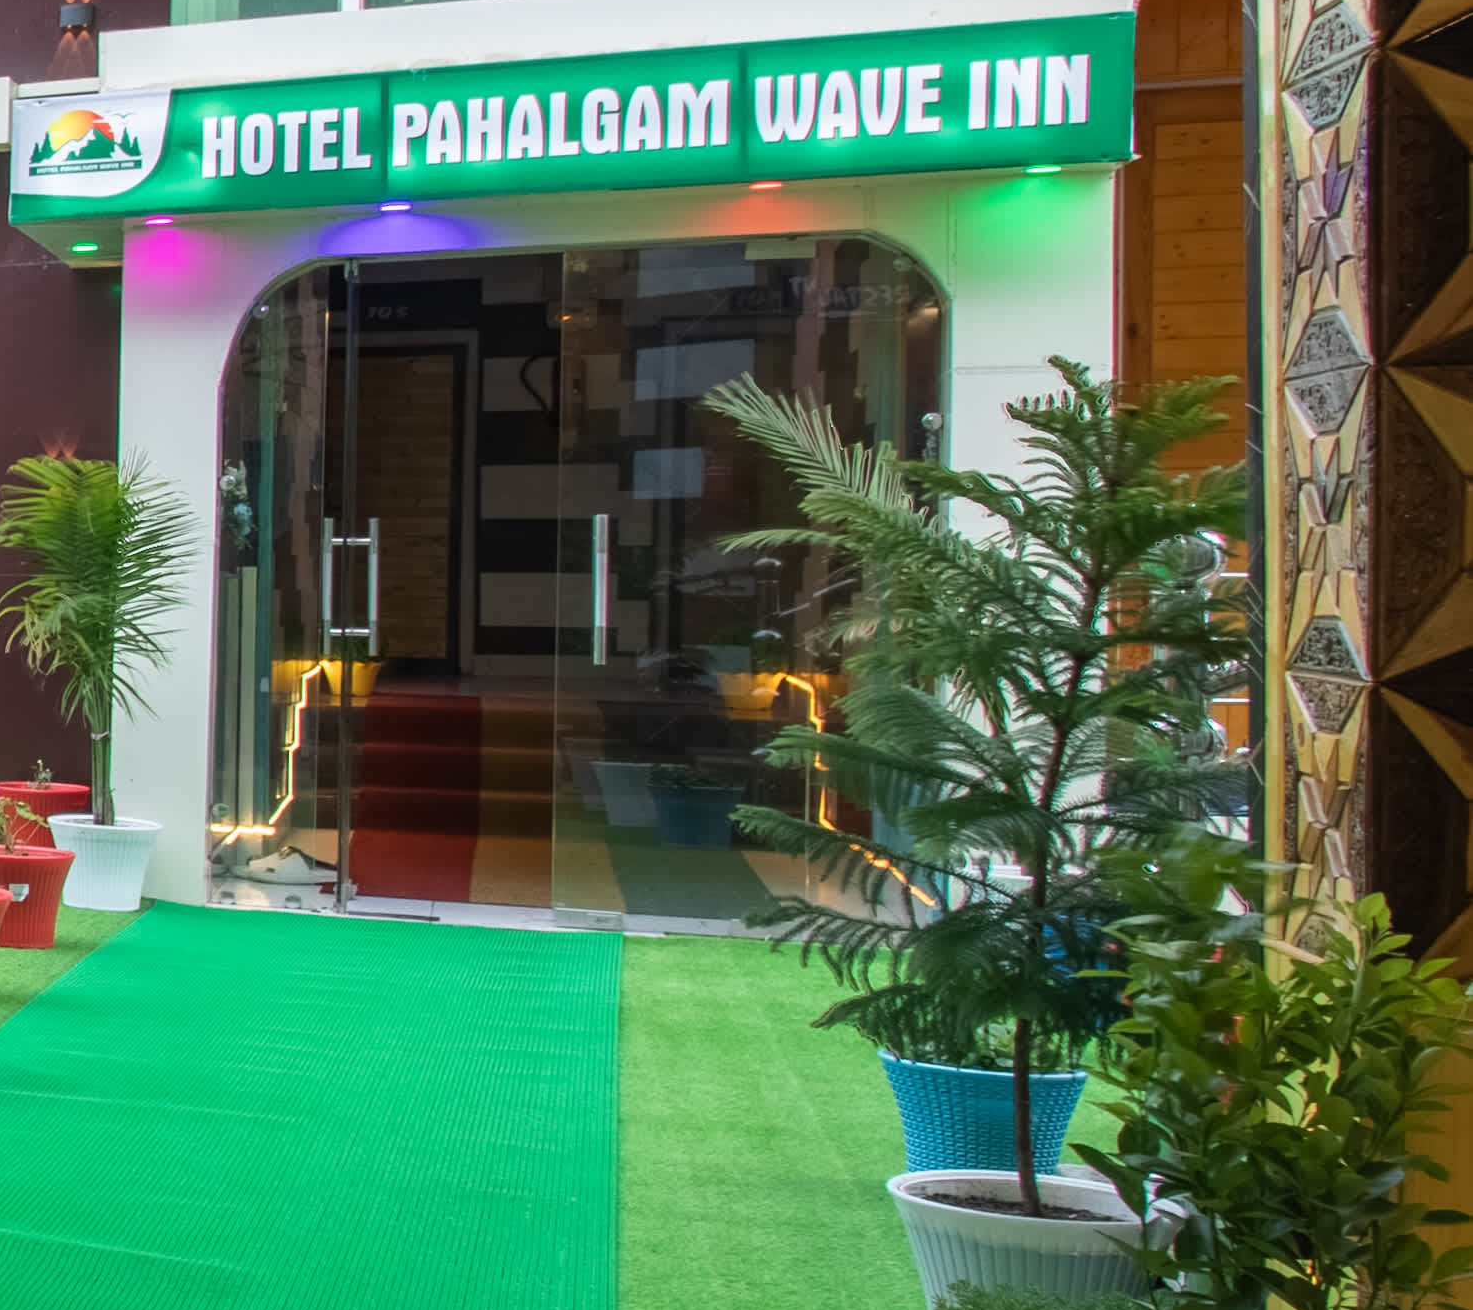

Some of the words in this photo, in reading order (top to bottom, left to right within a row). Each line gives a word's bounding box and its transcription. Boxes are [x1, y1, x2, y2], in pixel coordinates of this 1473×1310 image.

[201, 106, 373, 179] HOTEL
[392, 79, 732, 168] PAHALGAM
[754, 63, 943, 144] WAVE
[967, 54, 1092, 131] INN
